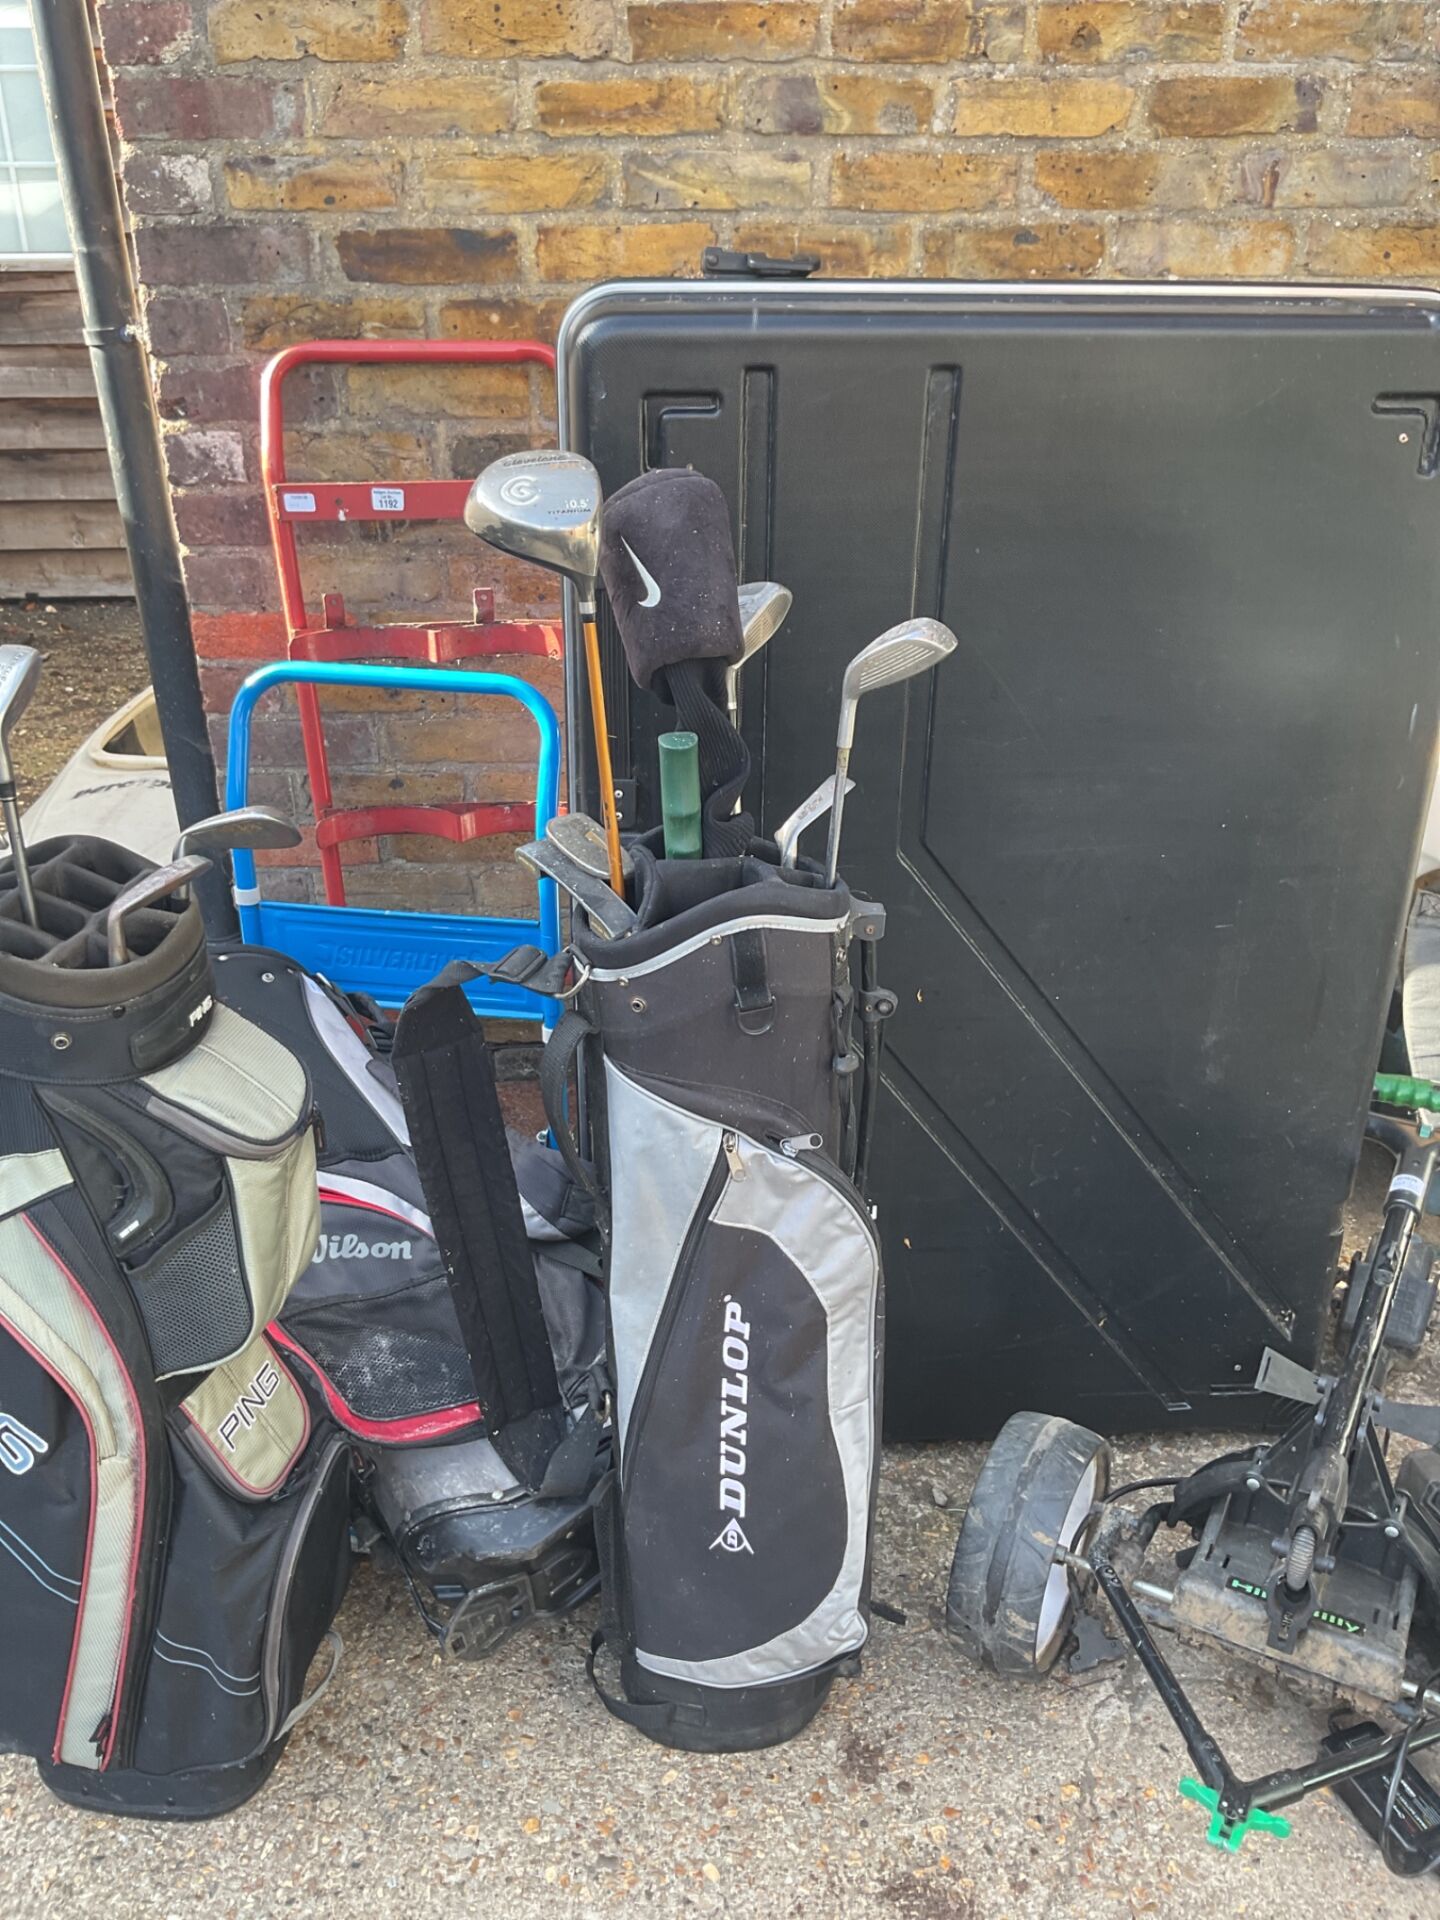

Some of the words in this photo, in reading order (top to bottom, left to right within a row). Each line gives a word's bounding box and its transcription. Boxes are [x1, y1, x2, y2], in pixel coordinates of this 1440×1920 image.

[379, 499, 398, 509] 1192
[218, 1360, 280, 1452] PING
[719, 1301, 750, 1518] DUNLOP
